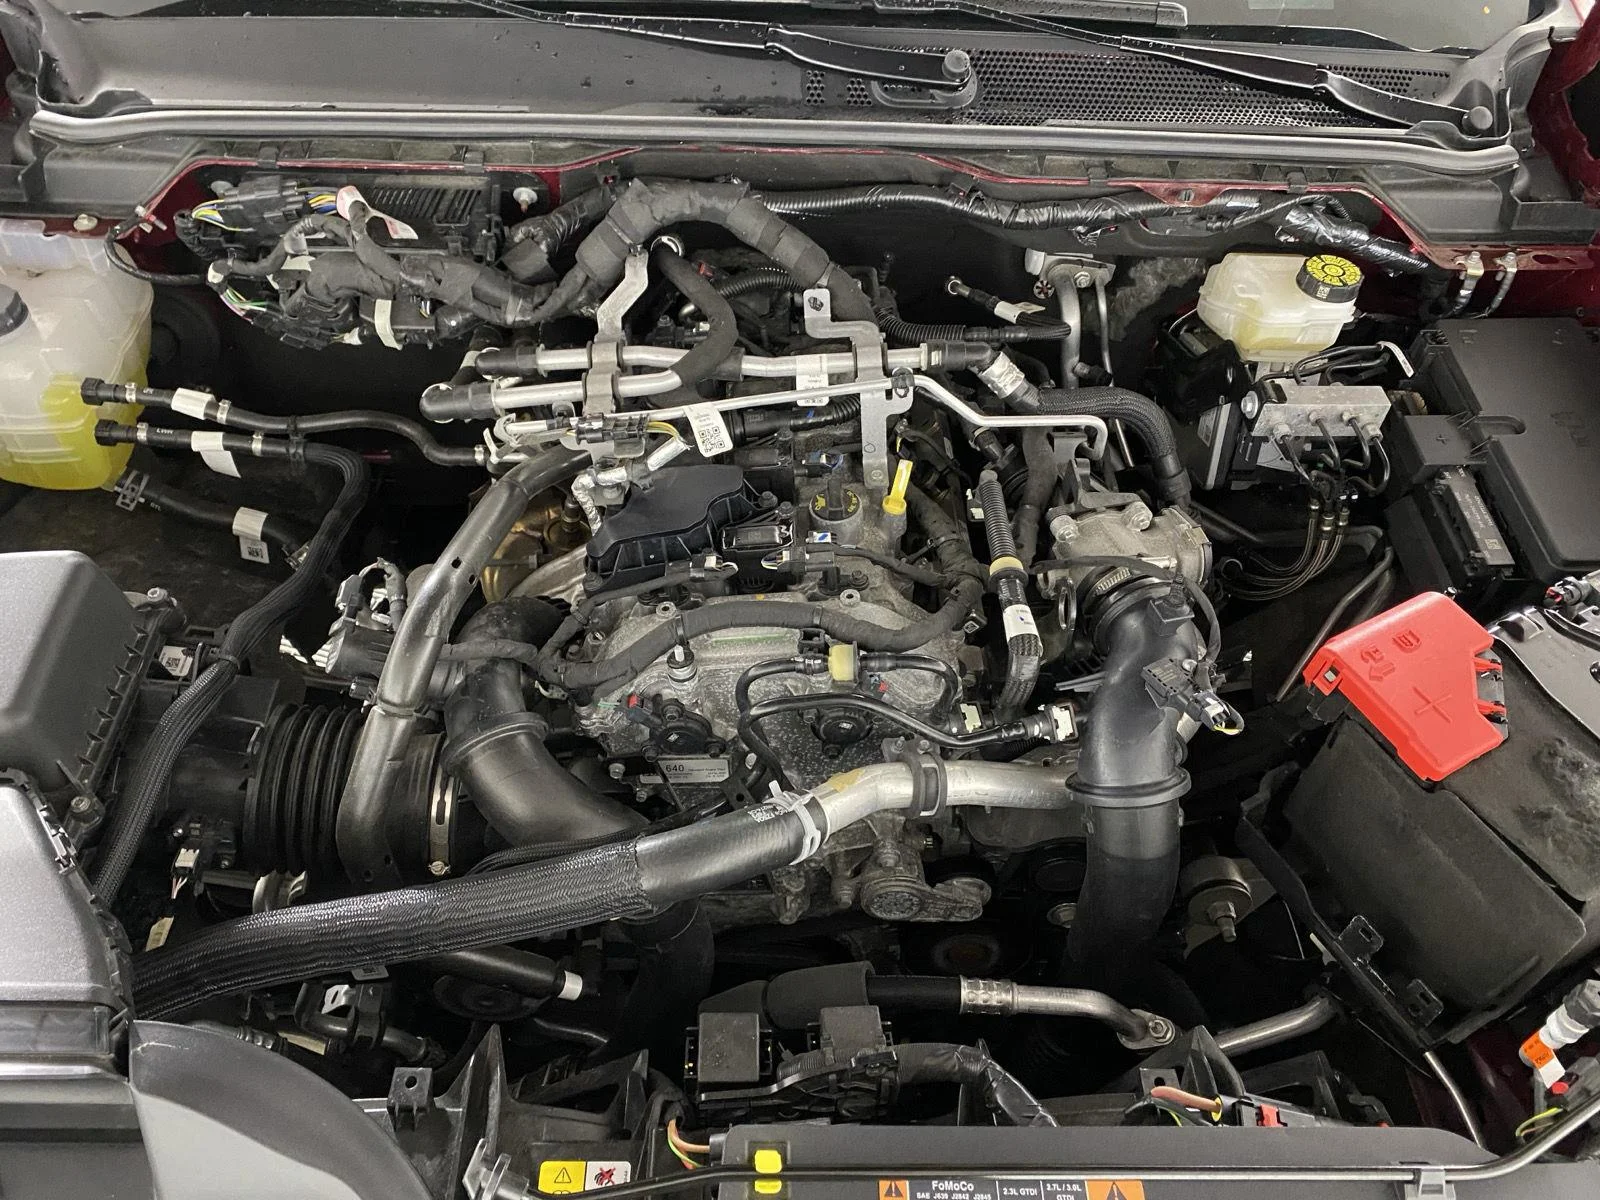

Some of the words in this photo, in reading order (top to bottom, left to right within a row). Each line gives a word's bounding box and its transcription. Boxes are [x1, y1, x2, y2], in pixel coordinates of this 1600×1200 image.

[665, 764, 684, 772] 640
[931, 1180, 974, 1191] FoMoCo
[1046, 1183, 1061, 1191] 2.7L
[1066, 1183, 1082, 1192] 3.0L
[1003, 1187, 1018, 1196] 2.3L
[1019, 1187, 1038, 1196] GTDI
